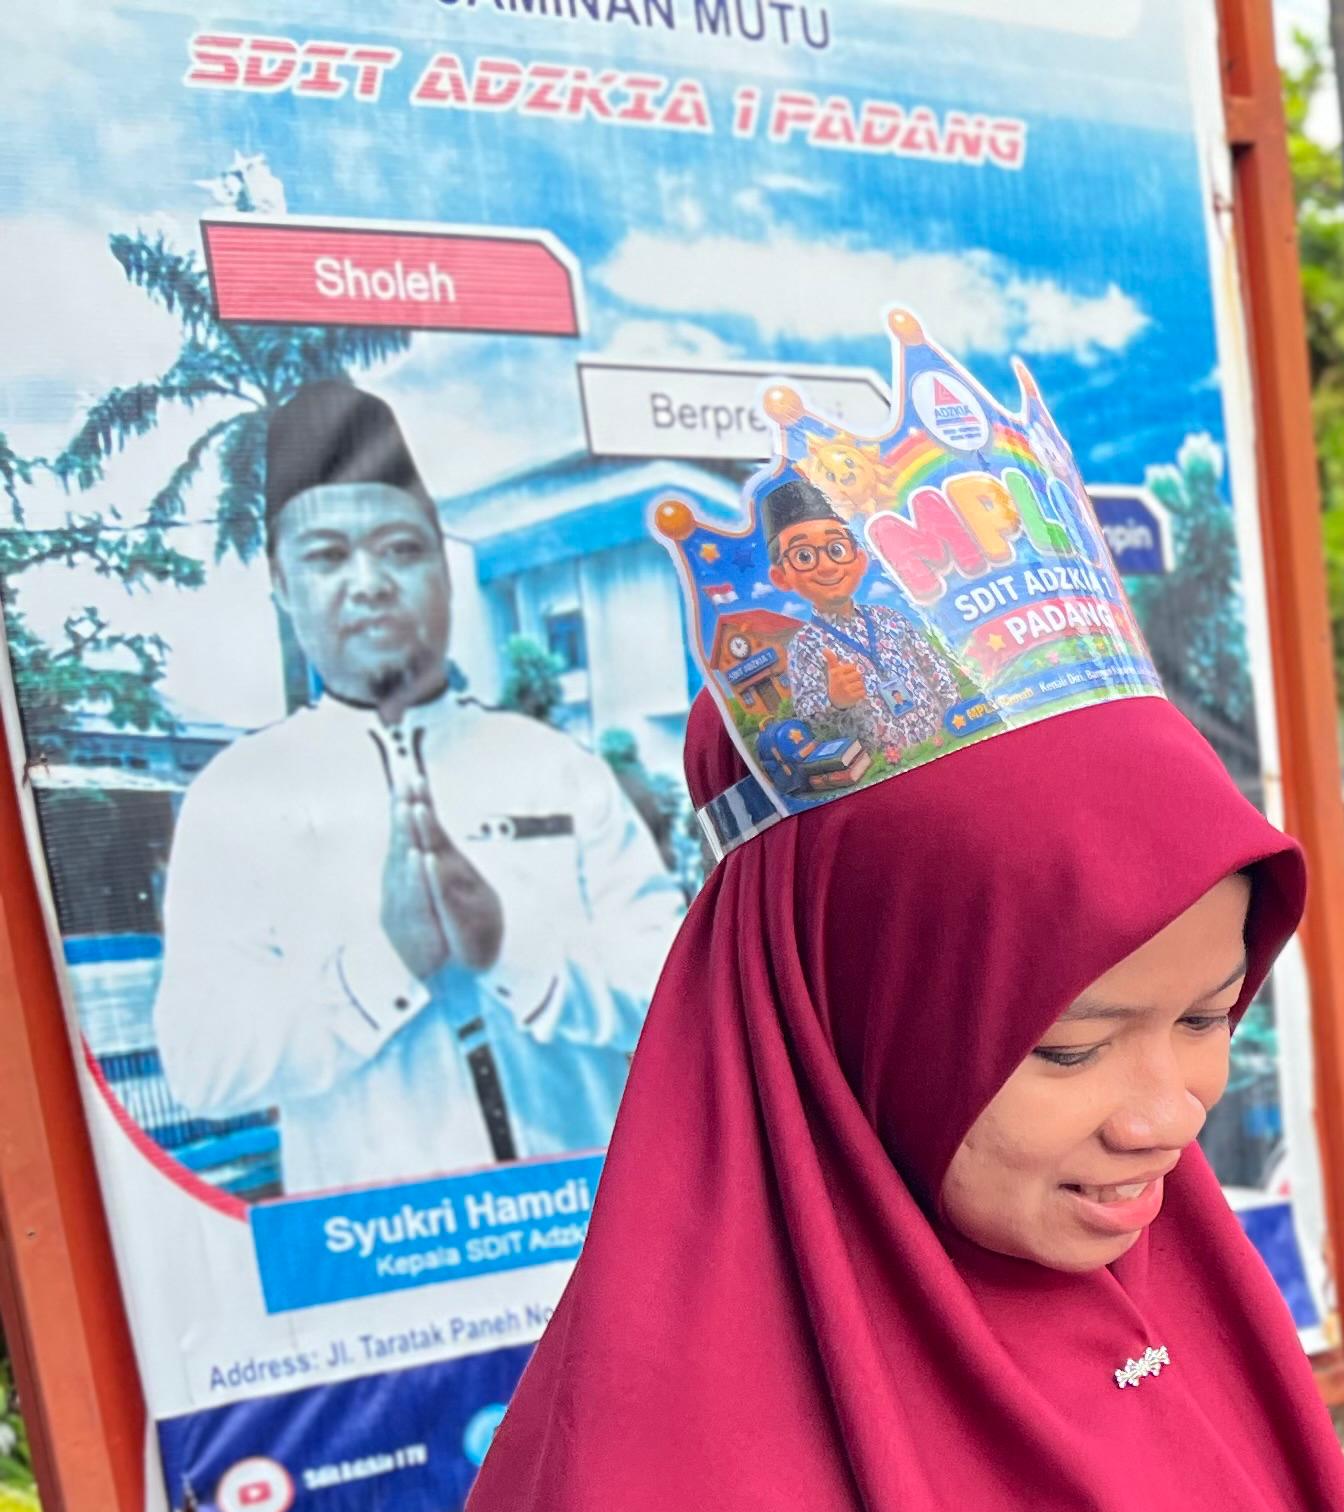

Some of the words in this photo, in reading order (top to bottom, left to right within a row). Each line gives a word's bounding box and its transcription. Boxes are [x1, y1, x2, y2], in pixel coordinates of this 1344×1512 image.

[695, 0, 830, 49] MUTU
[189, 34, 397, 96] SDIT
[415, 56, 708, 127] ADZKIA
[772, 93, 1024, 163] PADANG
[314, 259, 456, 303] Sholeh
[649, 393, 768, 441] Berpre
[954, 575, 1016, 622] SDIT
[1022, 563, 1101, 597] ADZKIA
[1004, 601, 1112, 645] PADANG
[323, 1197, 458, 1257] Syukri
[464, 1178, 591, 1229] Hamdi
[376, 1246, 461, 1277] Kepala
[465, 1230, 524, 1262] SDIT
[528, 1222, 588, 1250] Adzk
[209, 1353, 319, 1391] Address:
[359, 1326, 444, 1359] Taratak
[450, 1312, 521, 1342] Paneh
